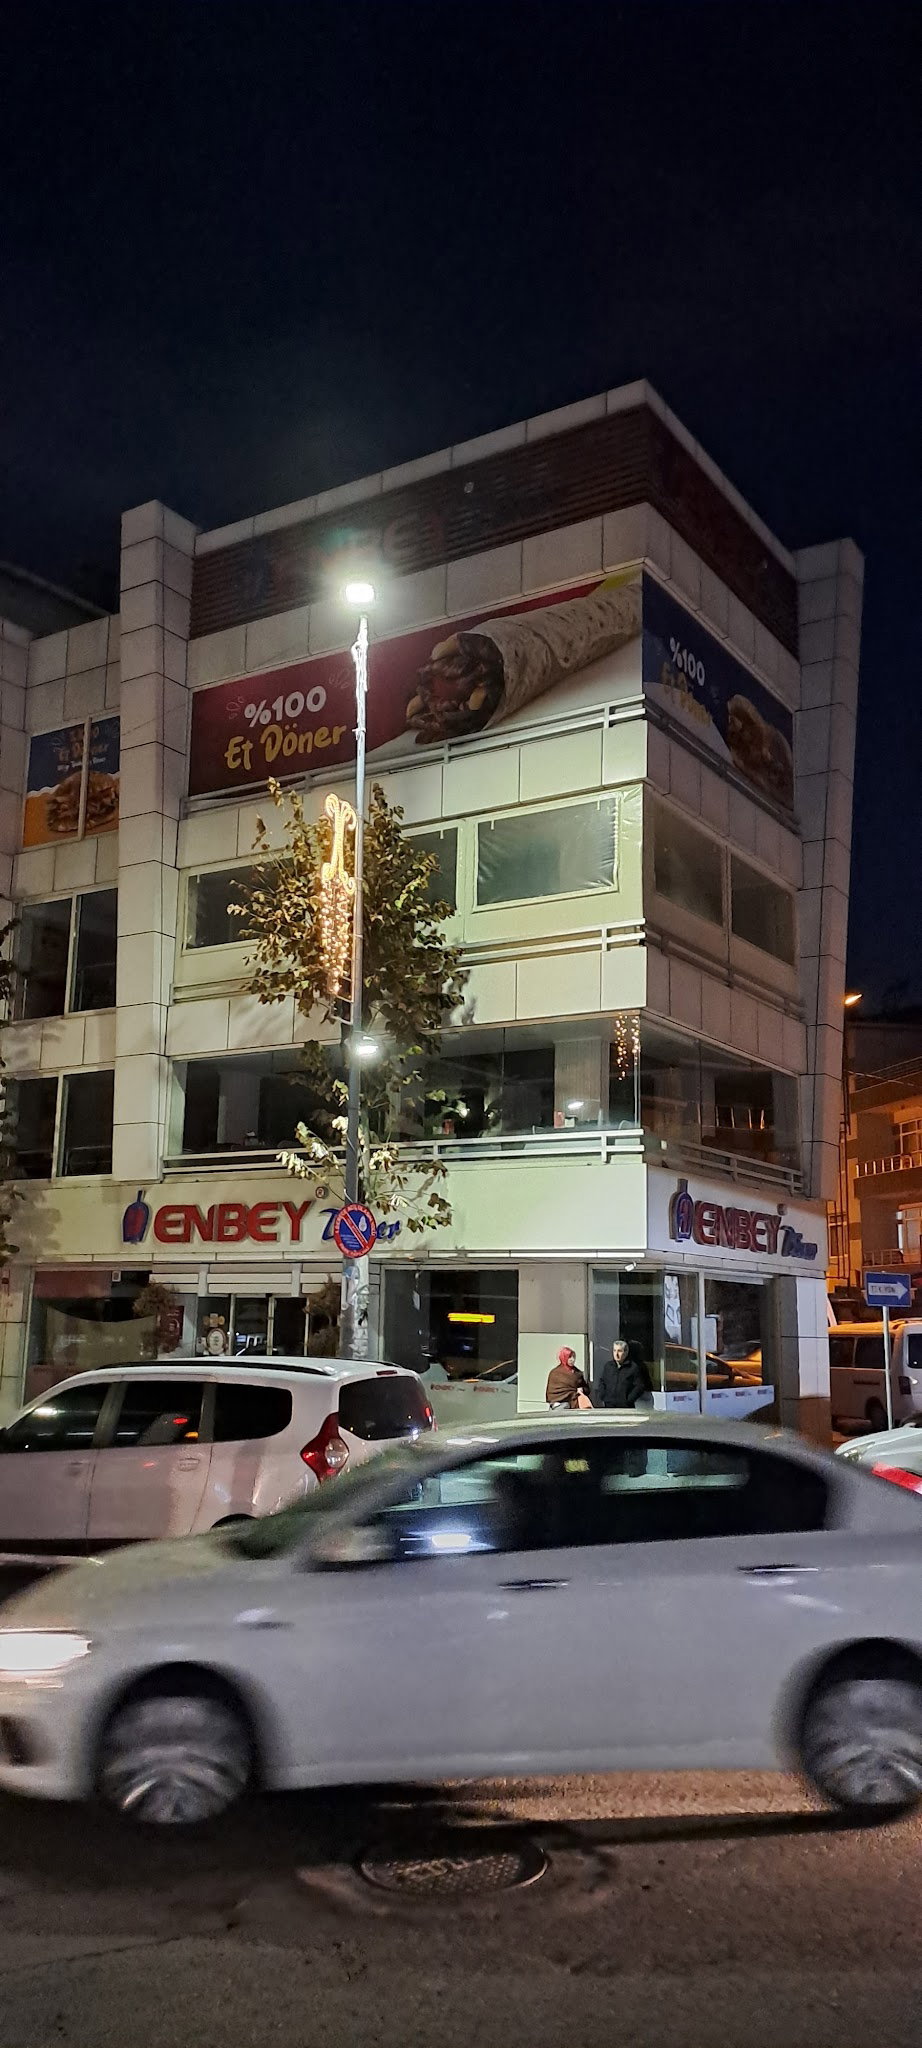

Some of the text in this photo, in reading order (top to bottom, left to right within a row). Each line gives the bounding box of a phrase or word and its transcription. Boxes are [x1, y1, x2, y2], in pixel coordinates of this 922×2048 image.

[669, 637, 705, 687] %100
[244, 685, 327, 727] %100
[224, 723, 347, 770] Et Döner
[153, 1199, 314, 1243] ENBEY
[693, 1200, 782, 1255] ENBEY
